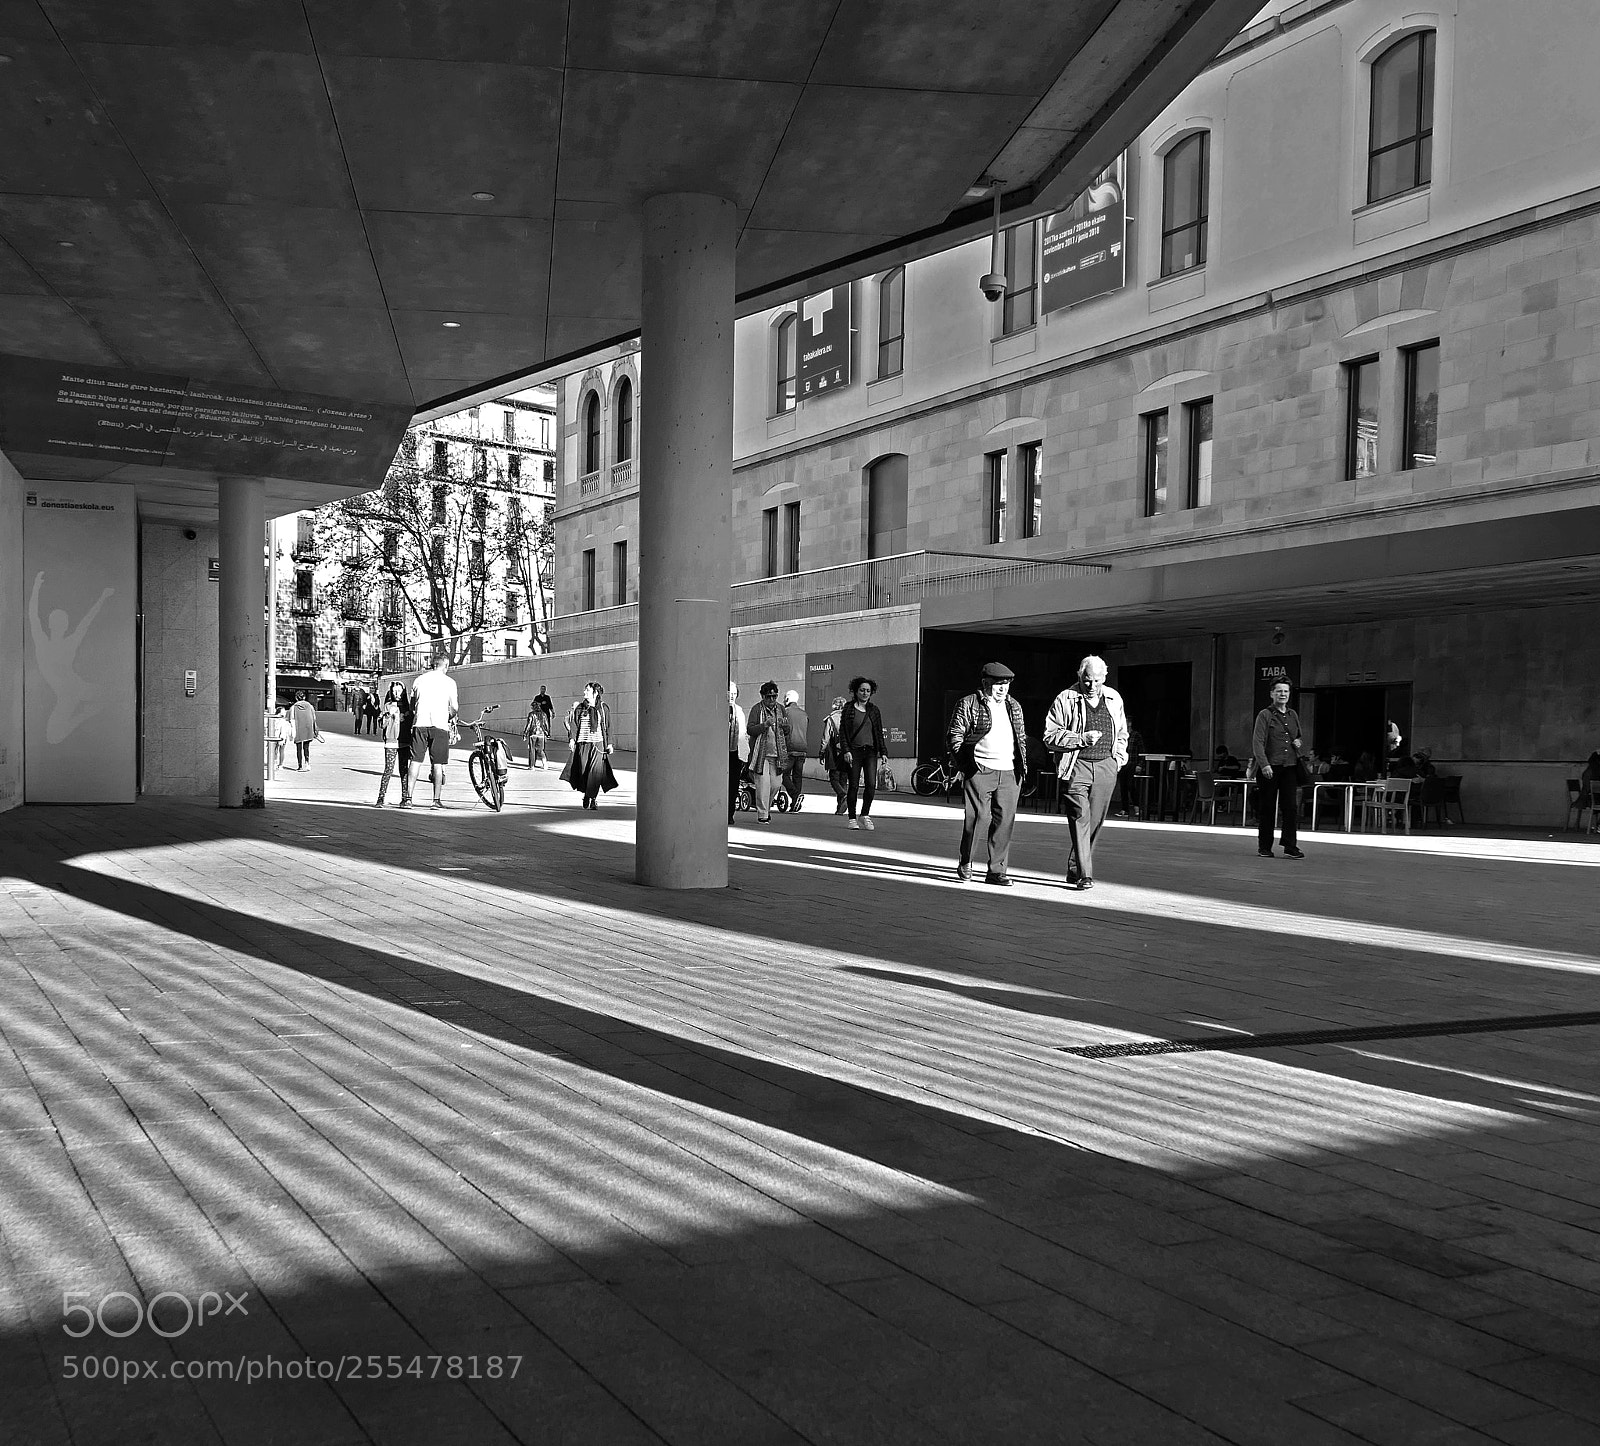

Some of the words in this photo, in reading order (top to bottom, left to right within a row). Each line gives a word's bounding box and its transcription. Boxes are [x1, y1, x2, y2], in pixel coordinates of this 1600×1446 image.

[61, 375, 84, 384] Maite
[86, 378, 105, 386] ditut
[107, 381, 129, 389] maite
[70, 391, 96, 400] llaman
[98, 394, 116, 402] hijos
[168, 404, 193, 412] porque
[75, 398, 104, 408] esquiva
[41, 501, 114, 511] donostiaeskola.eus
[1261, 666, 1287, 677] TABA
